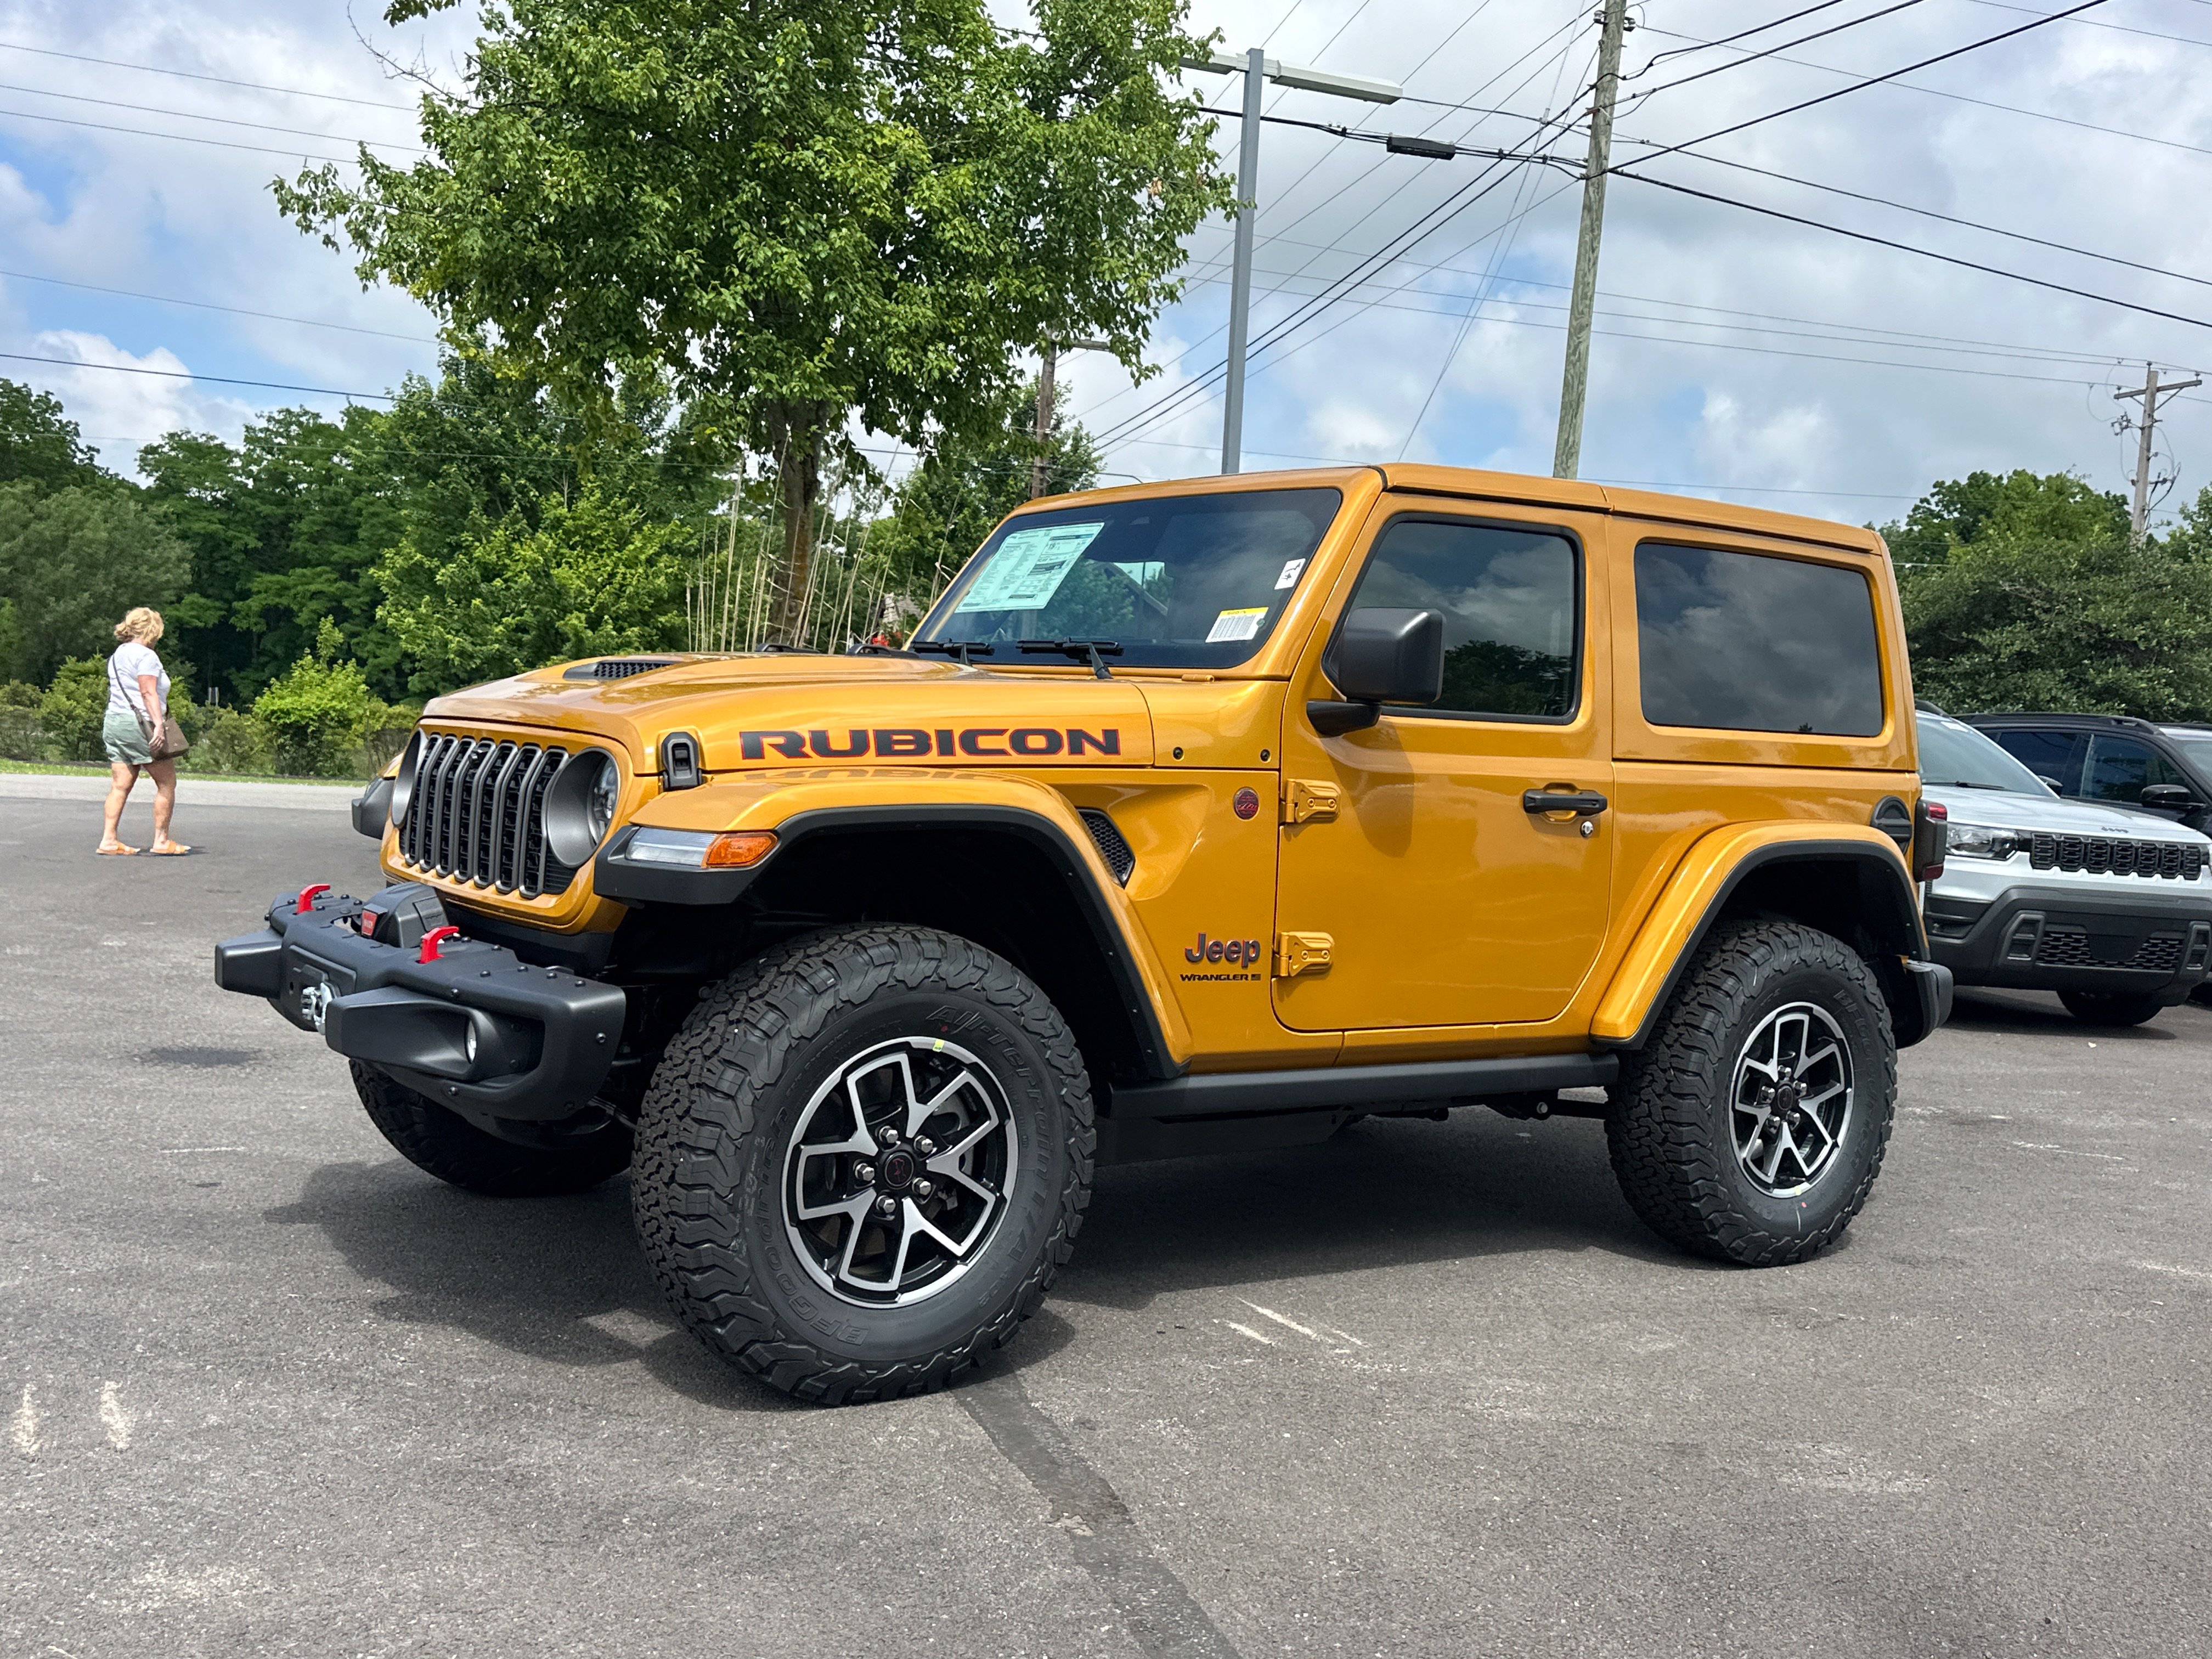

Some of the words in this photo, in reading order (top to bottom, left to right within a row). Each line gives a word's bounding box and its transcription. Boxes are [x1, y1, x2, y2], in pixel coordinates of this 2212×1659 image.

[739, 729, 1121, 760] RUBICON
[1184, 932, 1261, 968] Jeep
[1180, 973, 1249, 981] WRANGLER
[756, 1106, 870, 1346] BFGoodrich
